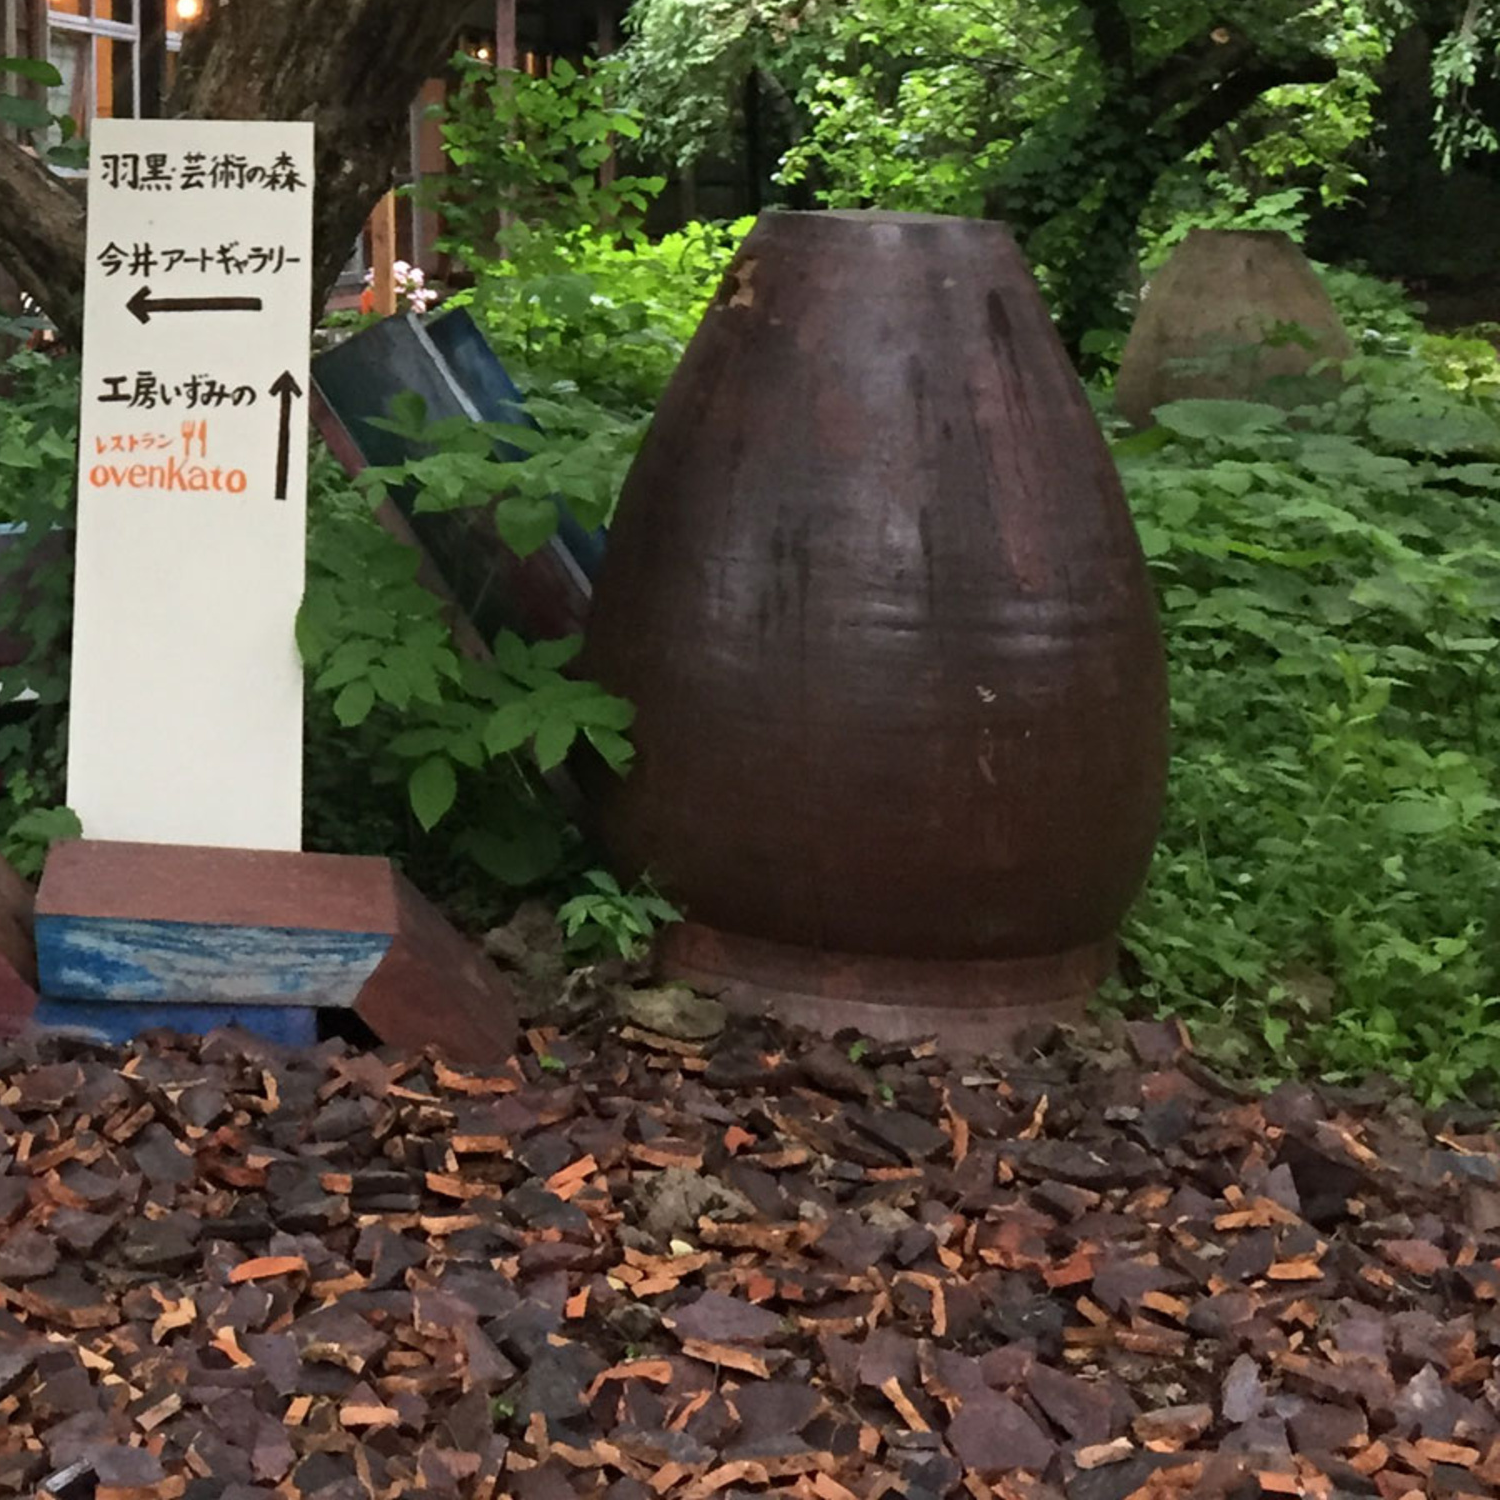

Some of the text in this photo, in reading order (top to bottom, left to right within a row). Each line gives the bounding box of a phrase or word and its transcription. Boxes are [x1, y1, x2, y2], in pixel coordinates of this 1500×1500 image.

[96, 370, 257, 410] 工房いずみの
[95, 432, 174, 455] レストラン
